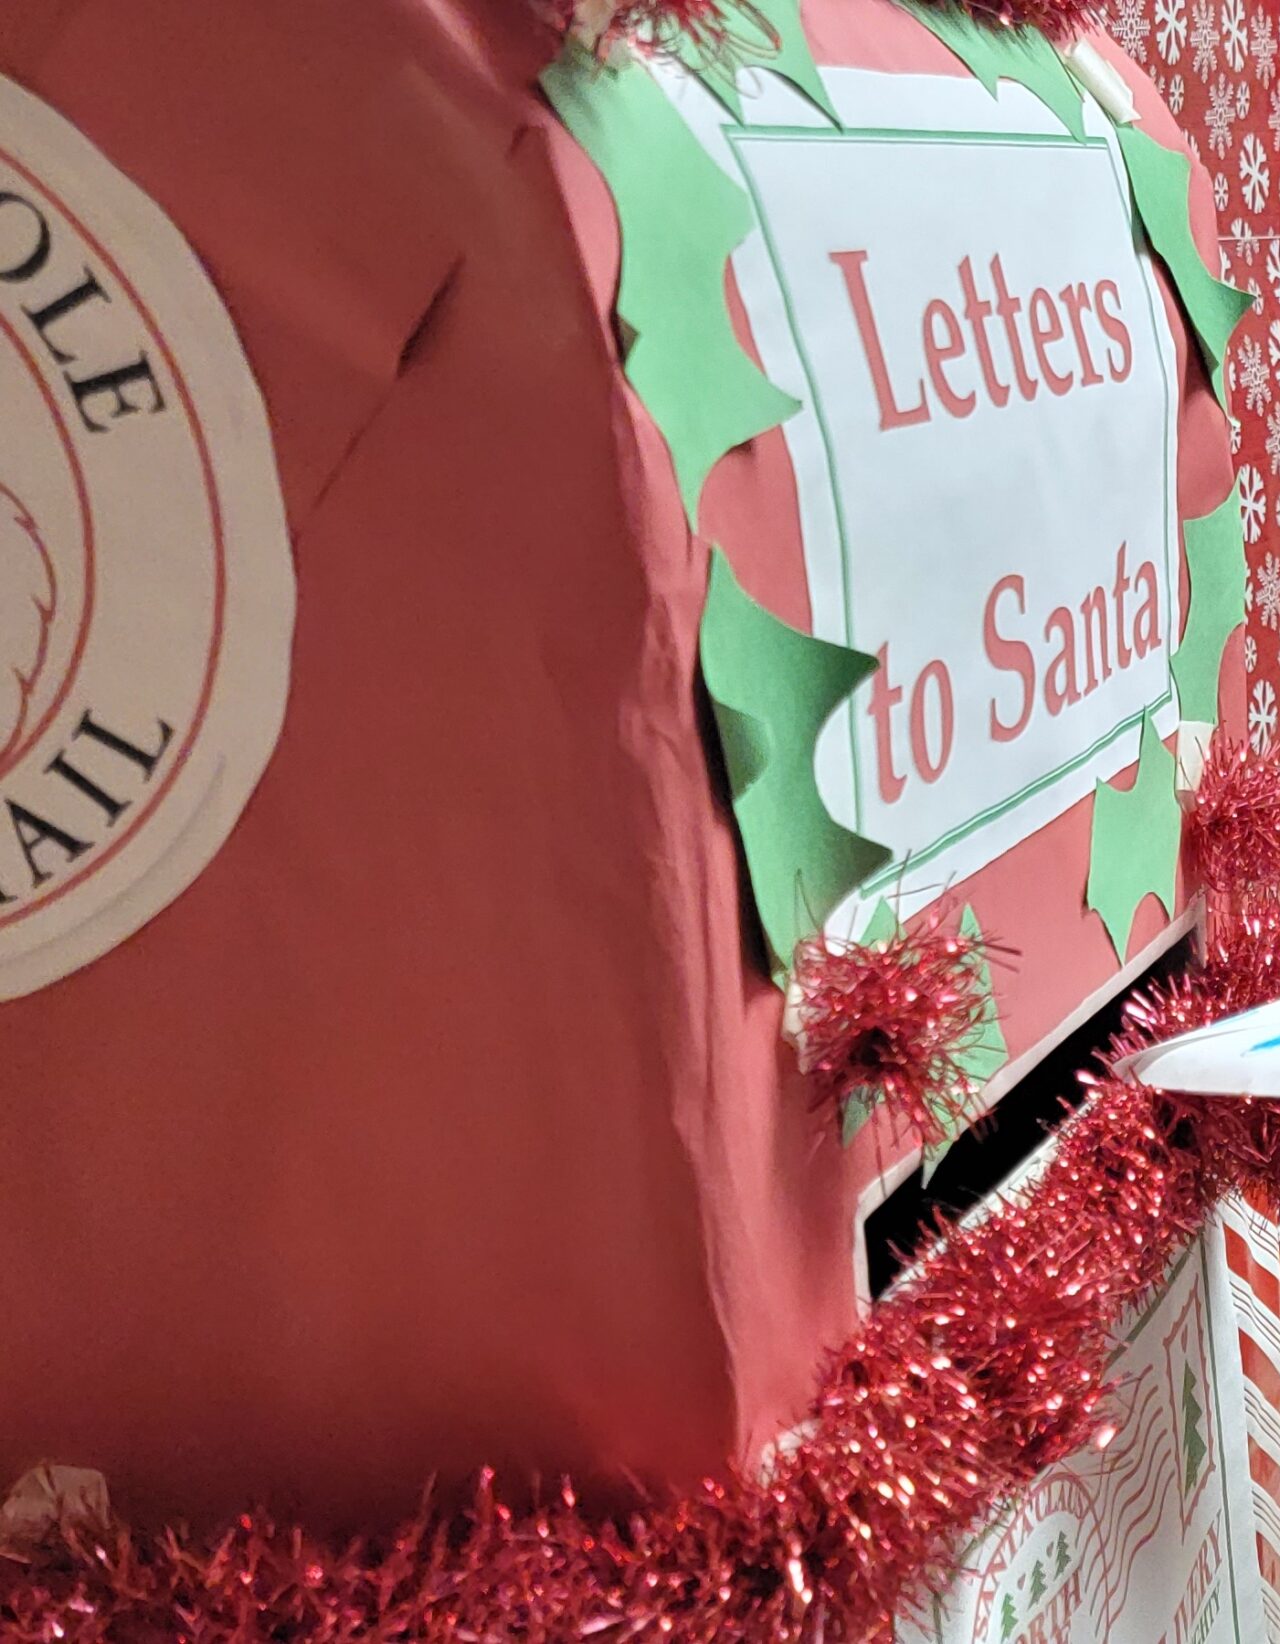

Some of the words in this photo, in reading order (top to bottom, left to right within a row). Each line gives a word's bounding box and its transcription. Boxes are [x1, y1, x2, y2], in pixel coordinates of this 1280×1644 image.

[828, 249, 1133, 431] Letters
[866, 640, 954, 804] to
[984, 540, 1162, 743] Santa
[0, 709, 174, 904] AIL
